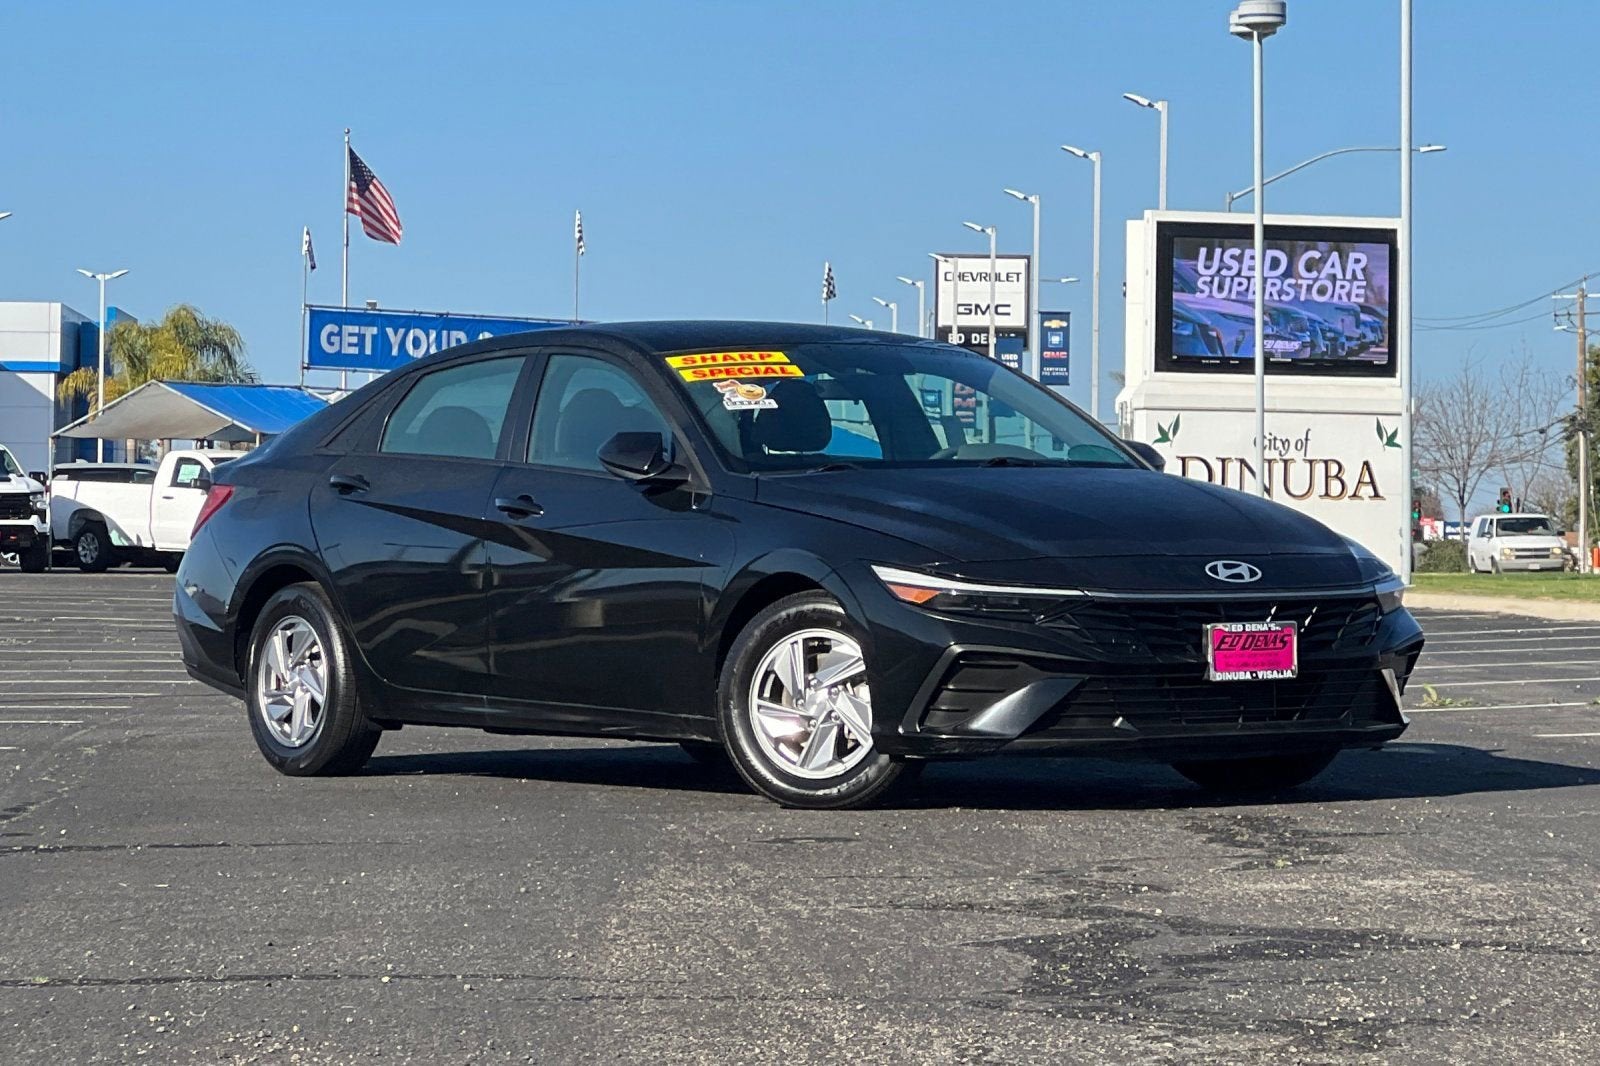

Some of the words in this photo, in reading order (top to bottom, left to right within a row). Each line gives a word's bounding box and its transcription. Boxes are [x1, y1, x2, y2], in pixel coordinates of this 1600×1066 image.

[1197, 247, 1288, 277] USED
[1298, 250, 1368, 280] CAR
[944, 271, 1022, 283] CEVRLET
[957, 303, 1011, 316] GMC
[320, 323, 378, 355] GET
[681, 353, 773, 365] SHARP
[1002, 361, 1019, 369] ARS
[691, 366, 797, 379] SPECIAL
[1294, 428, 1312, 457] of
[1176, 455, 1387, 501] DINUBA
[1231, 624, 1244, 632] ED
[1216, 671, 1252, 680] DINUBA
[1257, 669, 1293, 679] VISALIA
